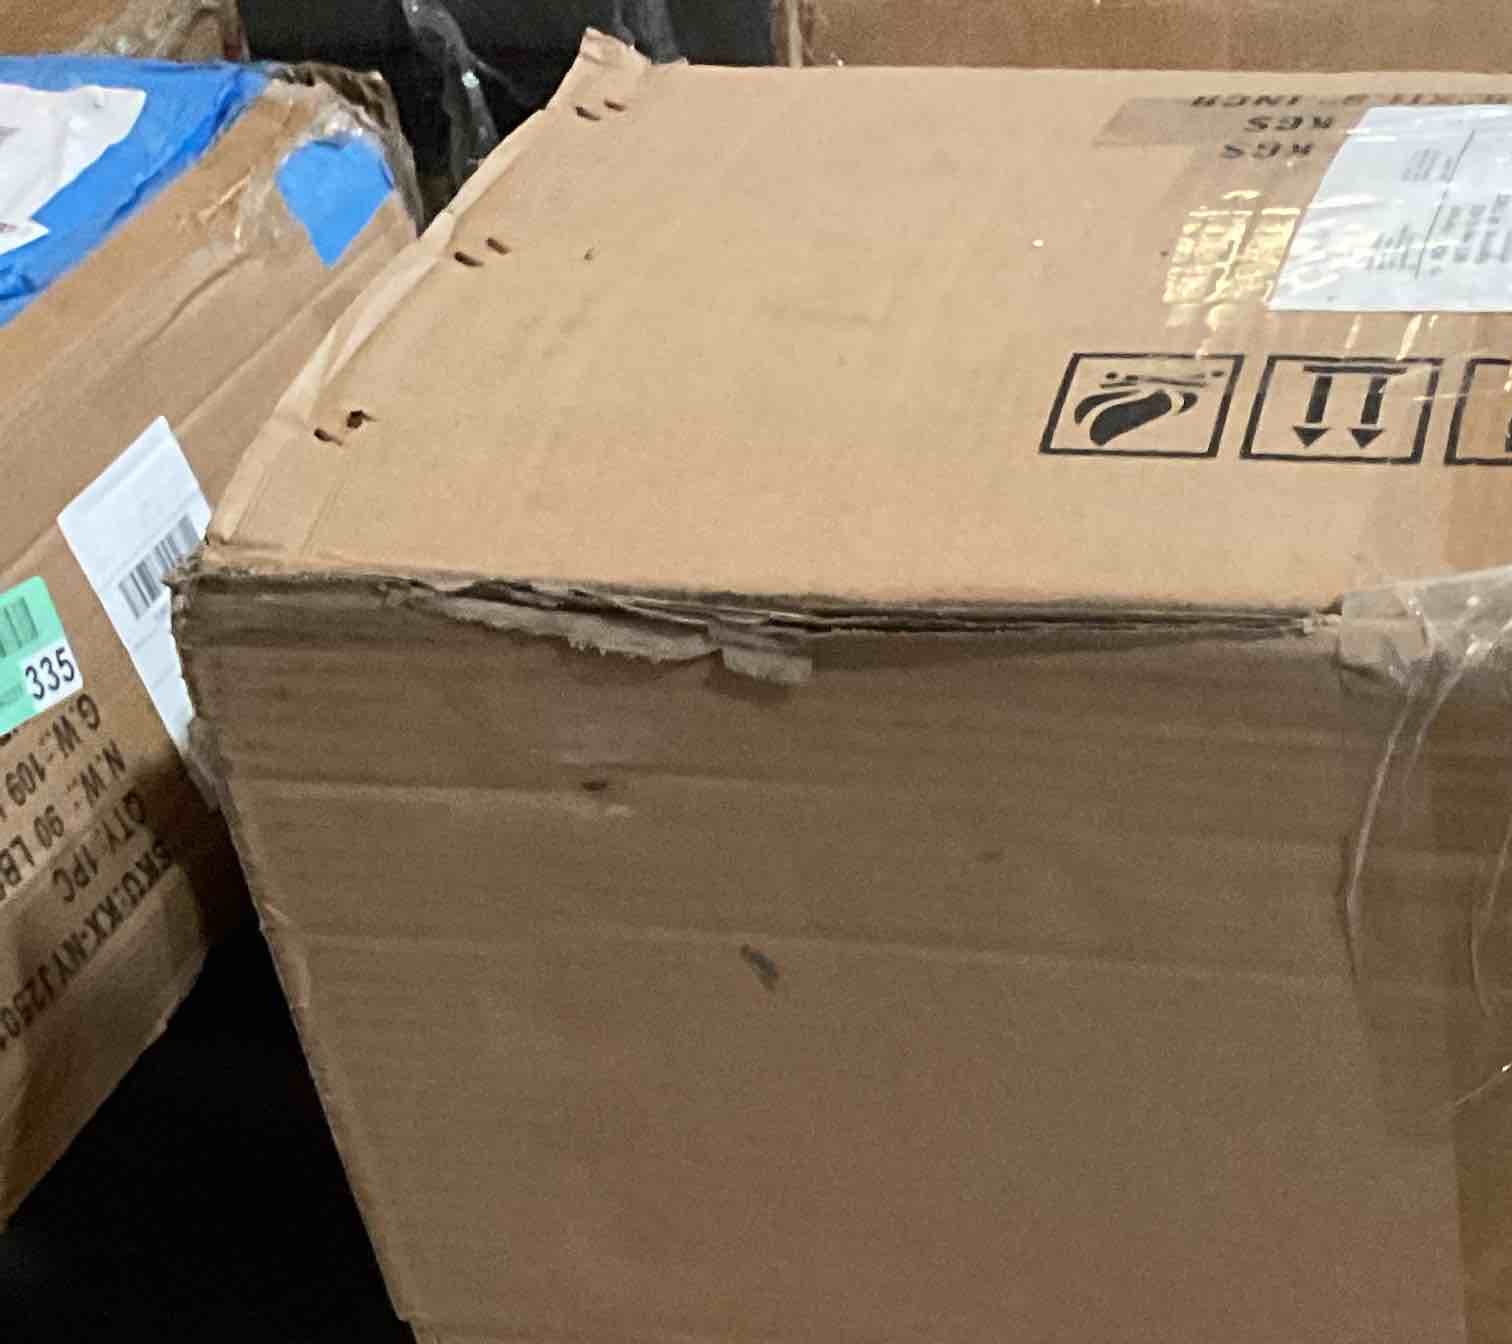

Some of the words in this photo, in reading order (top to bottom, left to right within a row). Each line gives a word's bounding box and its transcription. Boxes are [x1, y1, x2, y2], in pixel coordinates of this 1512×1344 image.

[1243, 115, 1335, 133] KGS
[1219, 143, 1316, 160] KGS
[24, 647, 76, 700] 335
[34, 804, 64, 850] 90
[52, 844, 98, 903] 1PC
